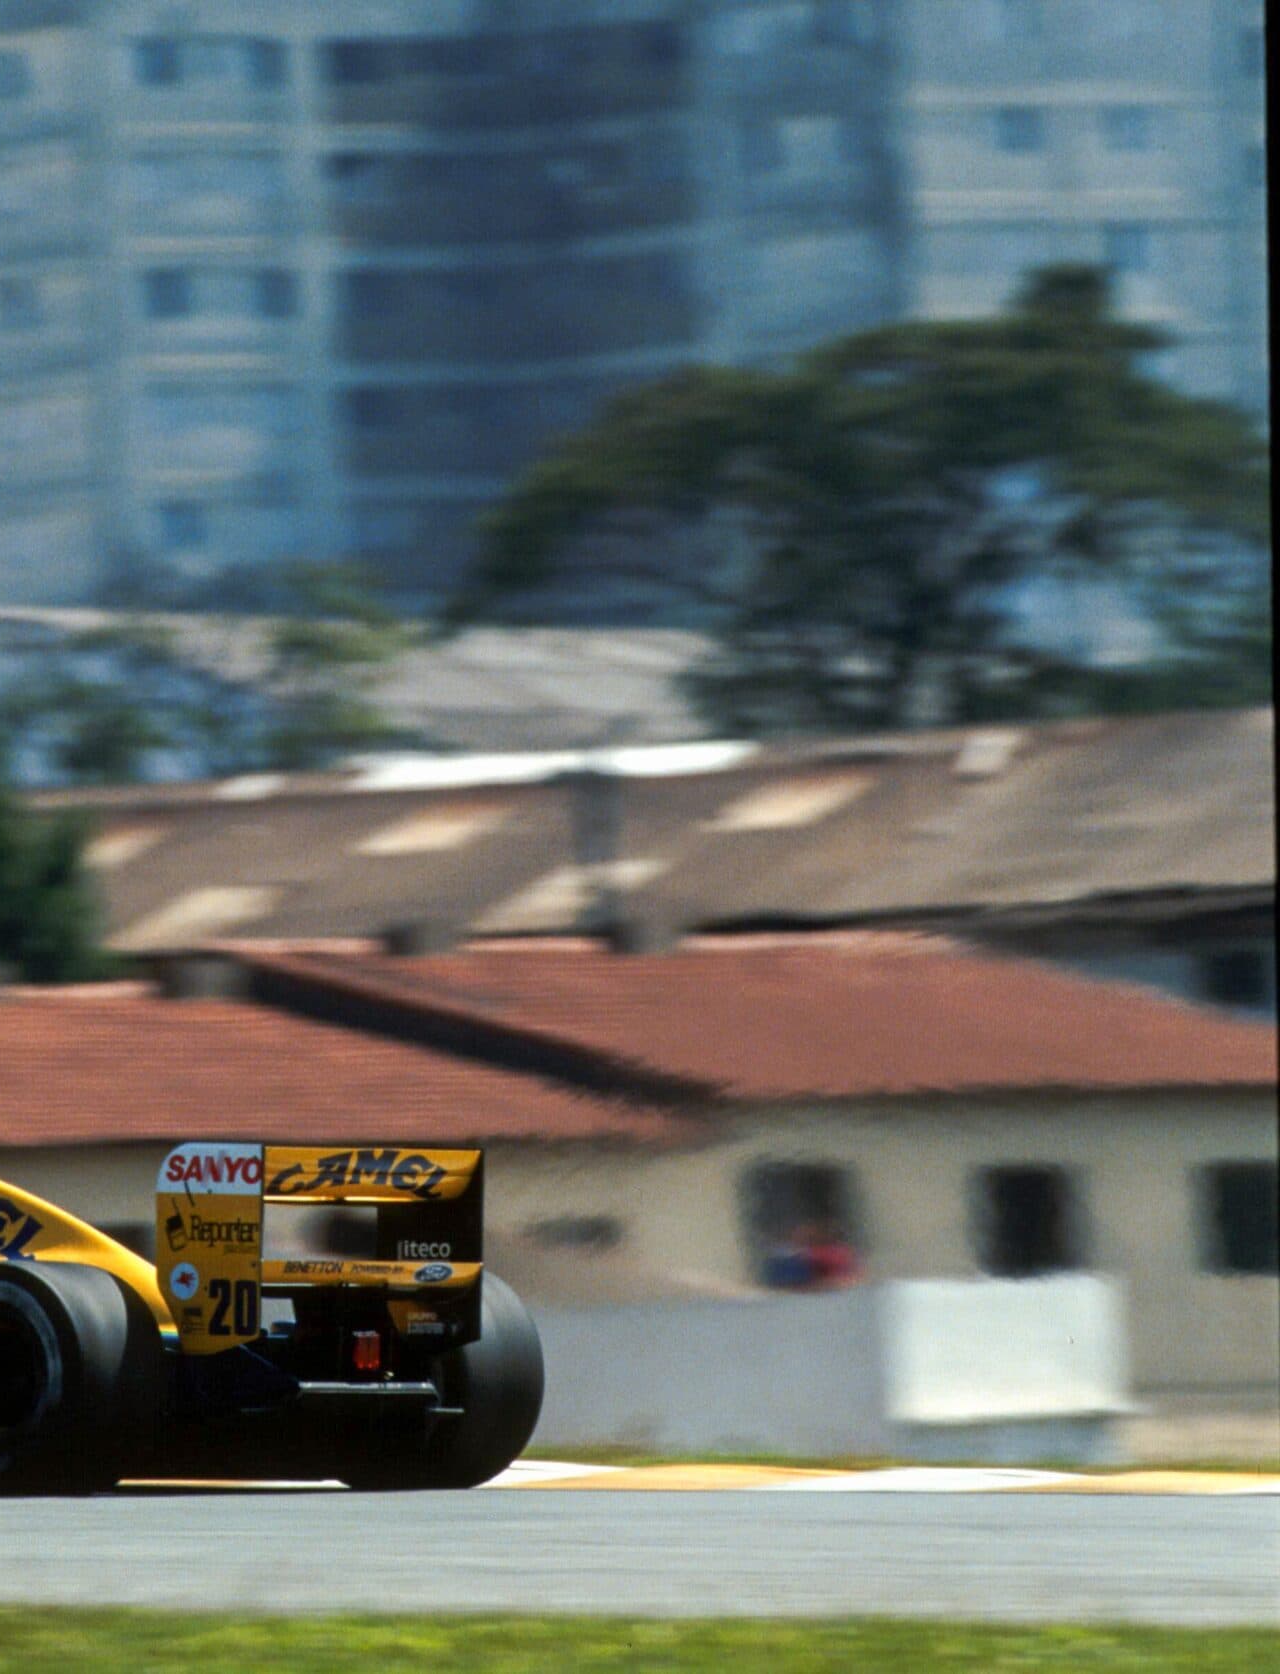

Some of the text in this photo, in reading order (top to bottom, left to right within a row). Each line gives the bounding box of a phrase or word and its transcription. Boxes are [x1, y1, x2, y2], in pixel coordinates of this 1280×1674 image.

[166, 1154, 263, 1184] SANYO
[265, 1150, 447, 1198] CAMEL
[188, 1215, 258, 1247] Reporter
[283, 1260, 342, 1273] BENETTON
[209, 1278, 257, 1336] 20
